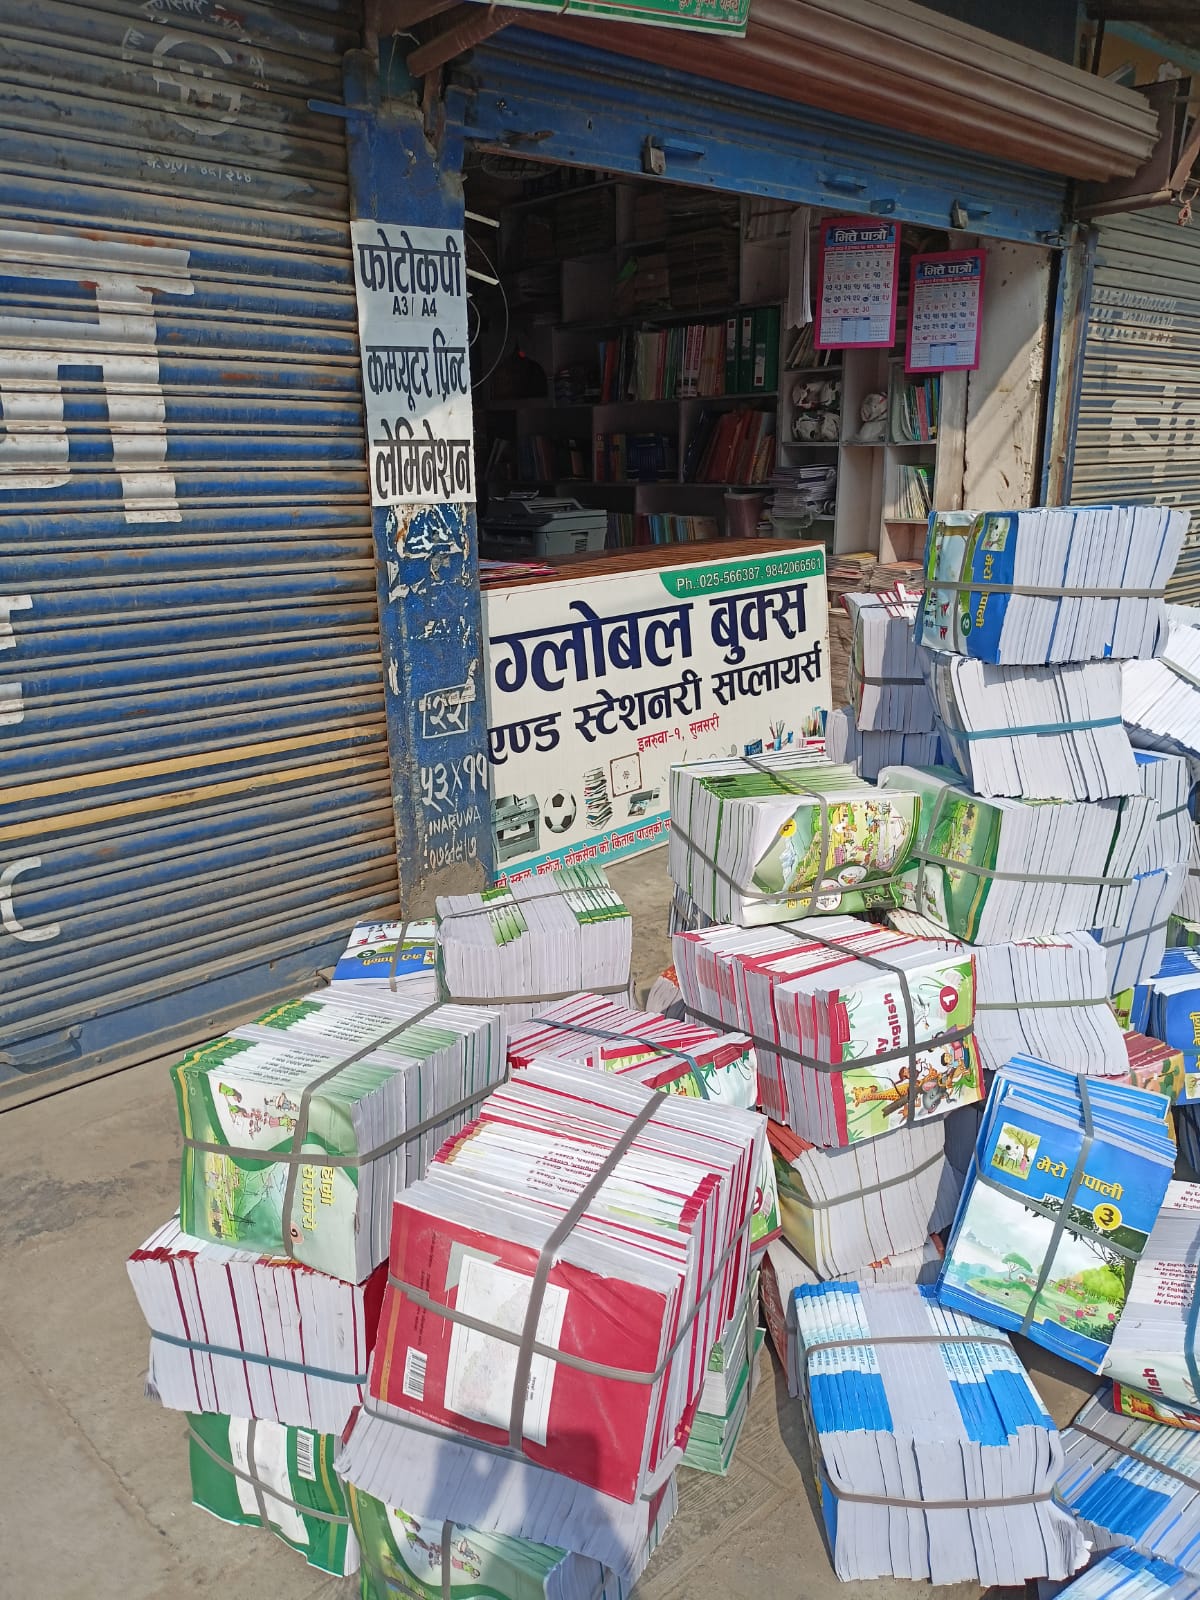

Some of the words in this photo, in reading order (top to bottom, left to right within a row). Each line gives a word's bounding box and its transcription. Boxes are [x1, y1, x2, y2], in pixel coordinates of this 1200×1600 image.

[357, 228, 462, 297] फोटोकपी
[421, 297, 438, 317] A4
[432, 327, 468, 402] प्रिन्ट
[373, 416, 471, 499] लेमिनेशन
[765, 557, 822, 577] 9842066561
[975, 591, 990, 628] पाली
[490, 601, 694, 693] ग्लोबल
[710, 583, 808, 665] बुक्स
[487, 711, 561, 766] एण्ड
[573, 669, 702, 743] स्टेशनरी
[711, 640, 823, 706] सप्लायर्स
[689, 713, 720, 738] सुनसरी
[429, 806, 482, 835] INARUWA
[599, 836, 610, 854] को
[943, 993, 956, 1006] 1
[883, 993, 901, 1053] nglish
[1036, 1157, 1069, 1179] मेरो
[1100, 1207, 1117, 1227] ३
